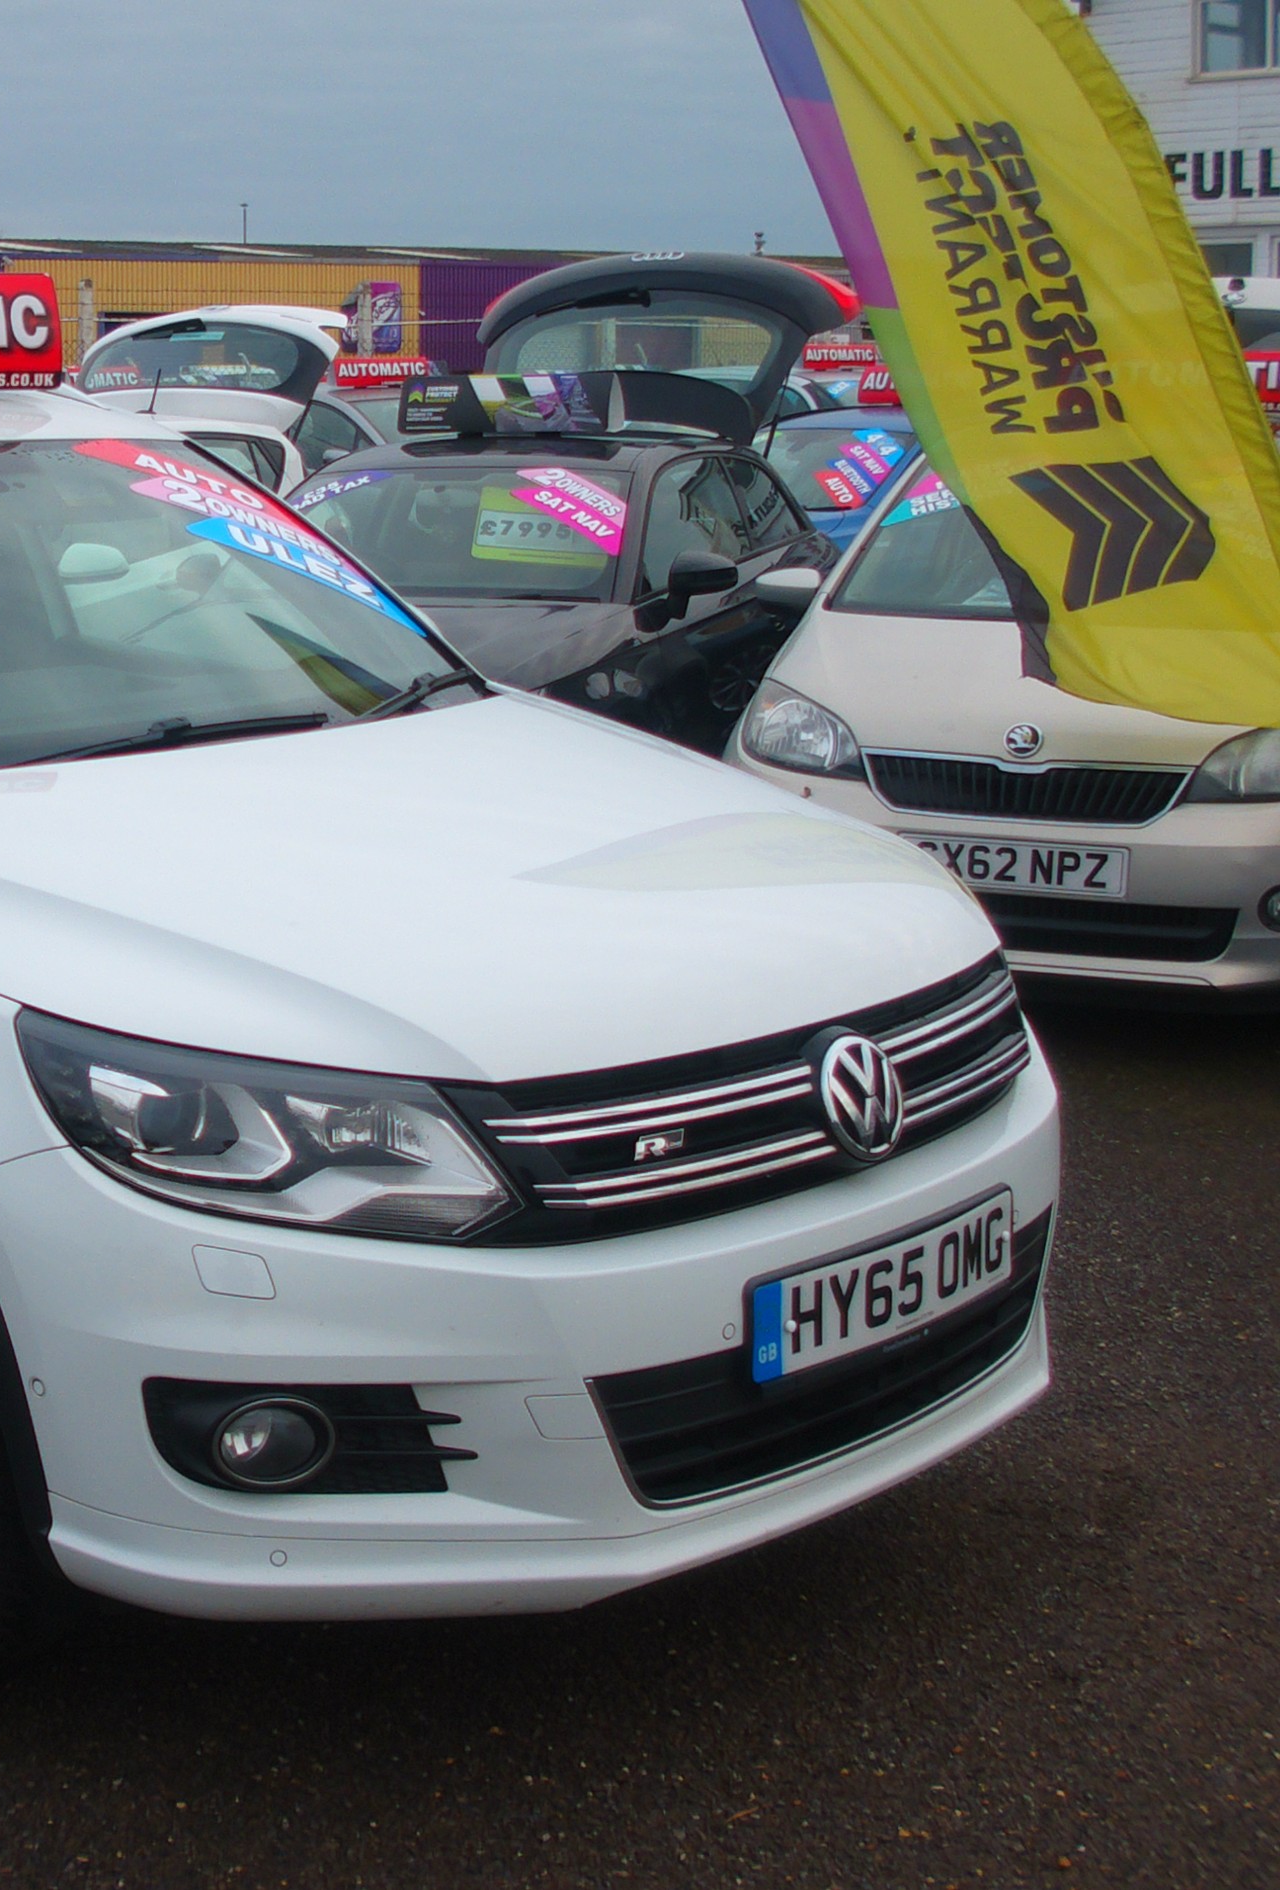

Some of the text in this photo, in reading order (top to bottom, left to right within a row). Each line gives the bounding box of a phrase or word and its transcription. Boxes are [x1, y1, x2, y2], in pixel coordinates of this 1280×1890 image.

[806, 348, 874, 362] AUTOMATIC
[338, 361, 426, 379] AUTOMATIC
[850, 445, 867, 461] SAT
[134, 453, 264, 510] AUTO
[330, 476, 370, 494] TAX
[825, 477, 853, 503] AUTO
[534, 491, 615, 538] SAT NAV
[480, 520, 569, 540] £7995
[227, 524, 385, 609] ULEZ
[917, 841, 1108, 889] X62 NPZ
[791, 1207, 1003, 1354] HY65 OMG
[758, 1342, 778, 1364] GB
